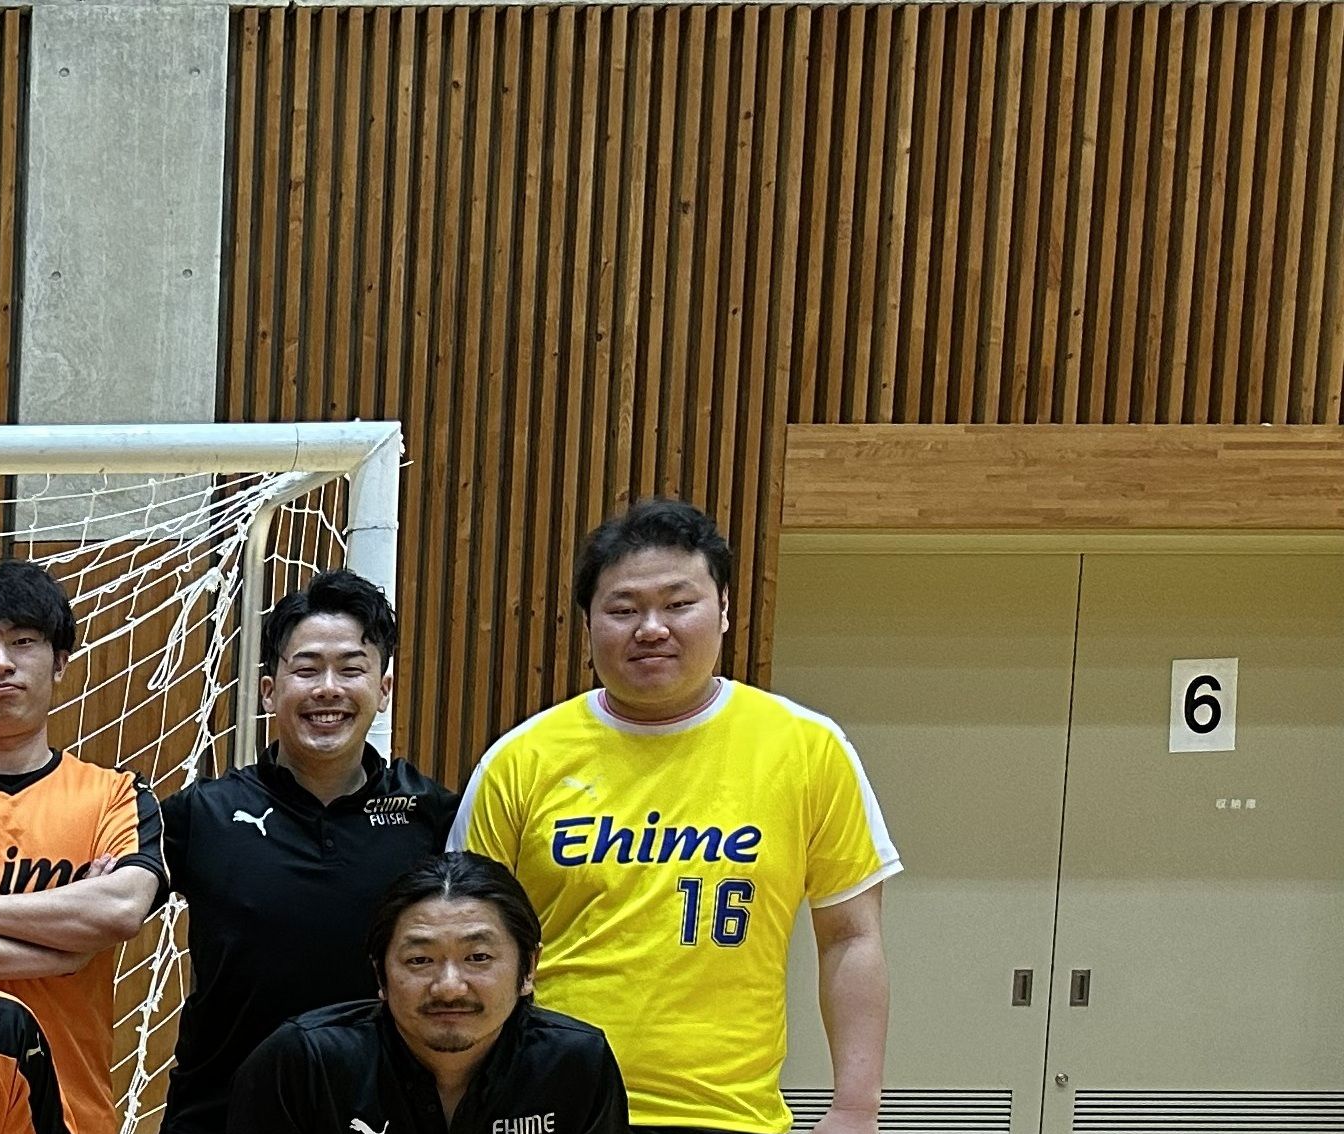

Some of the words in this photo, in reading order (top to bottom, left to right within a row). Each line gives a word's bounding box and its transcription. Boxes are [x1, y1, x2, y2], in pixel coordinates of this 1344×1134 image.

[1185, 675, 1221, 734] 6
[370, 812, 409, 826] FUTSAL
[552, 811, 762, 866] Ehime
[677, 877, 755, 947] 16
